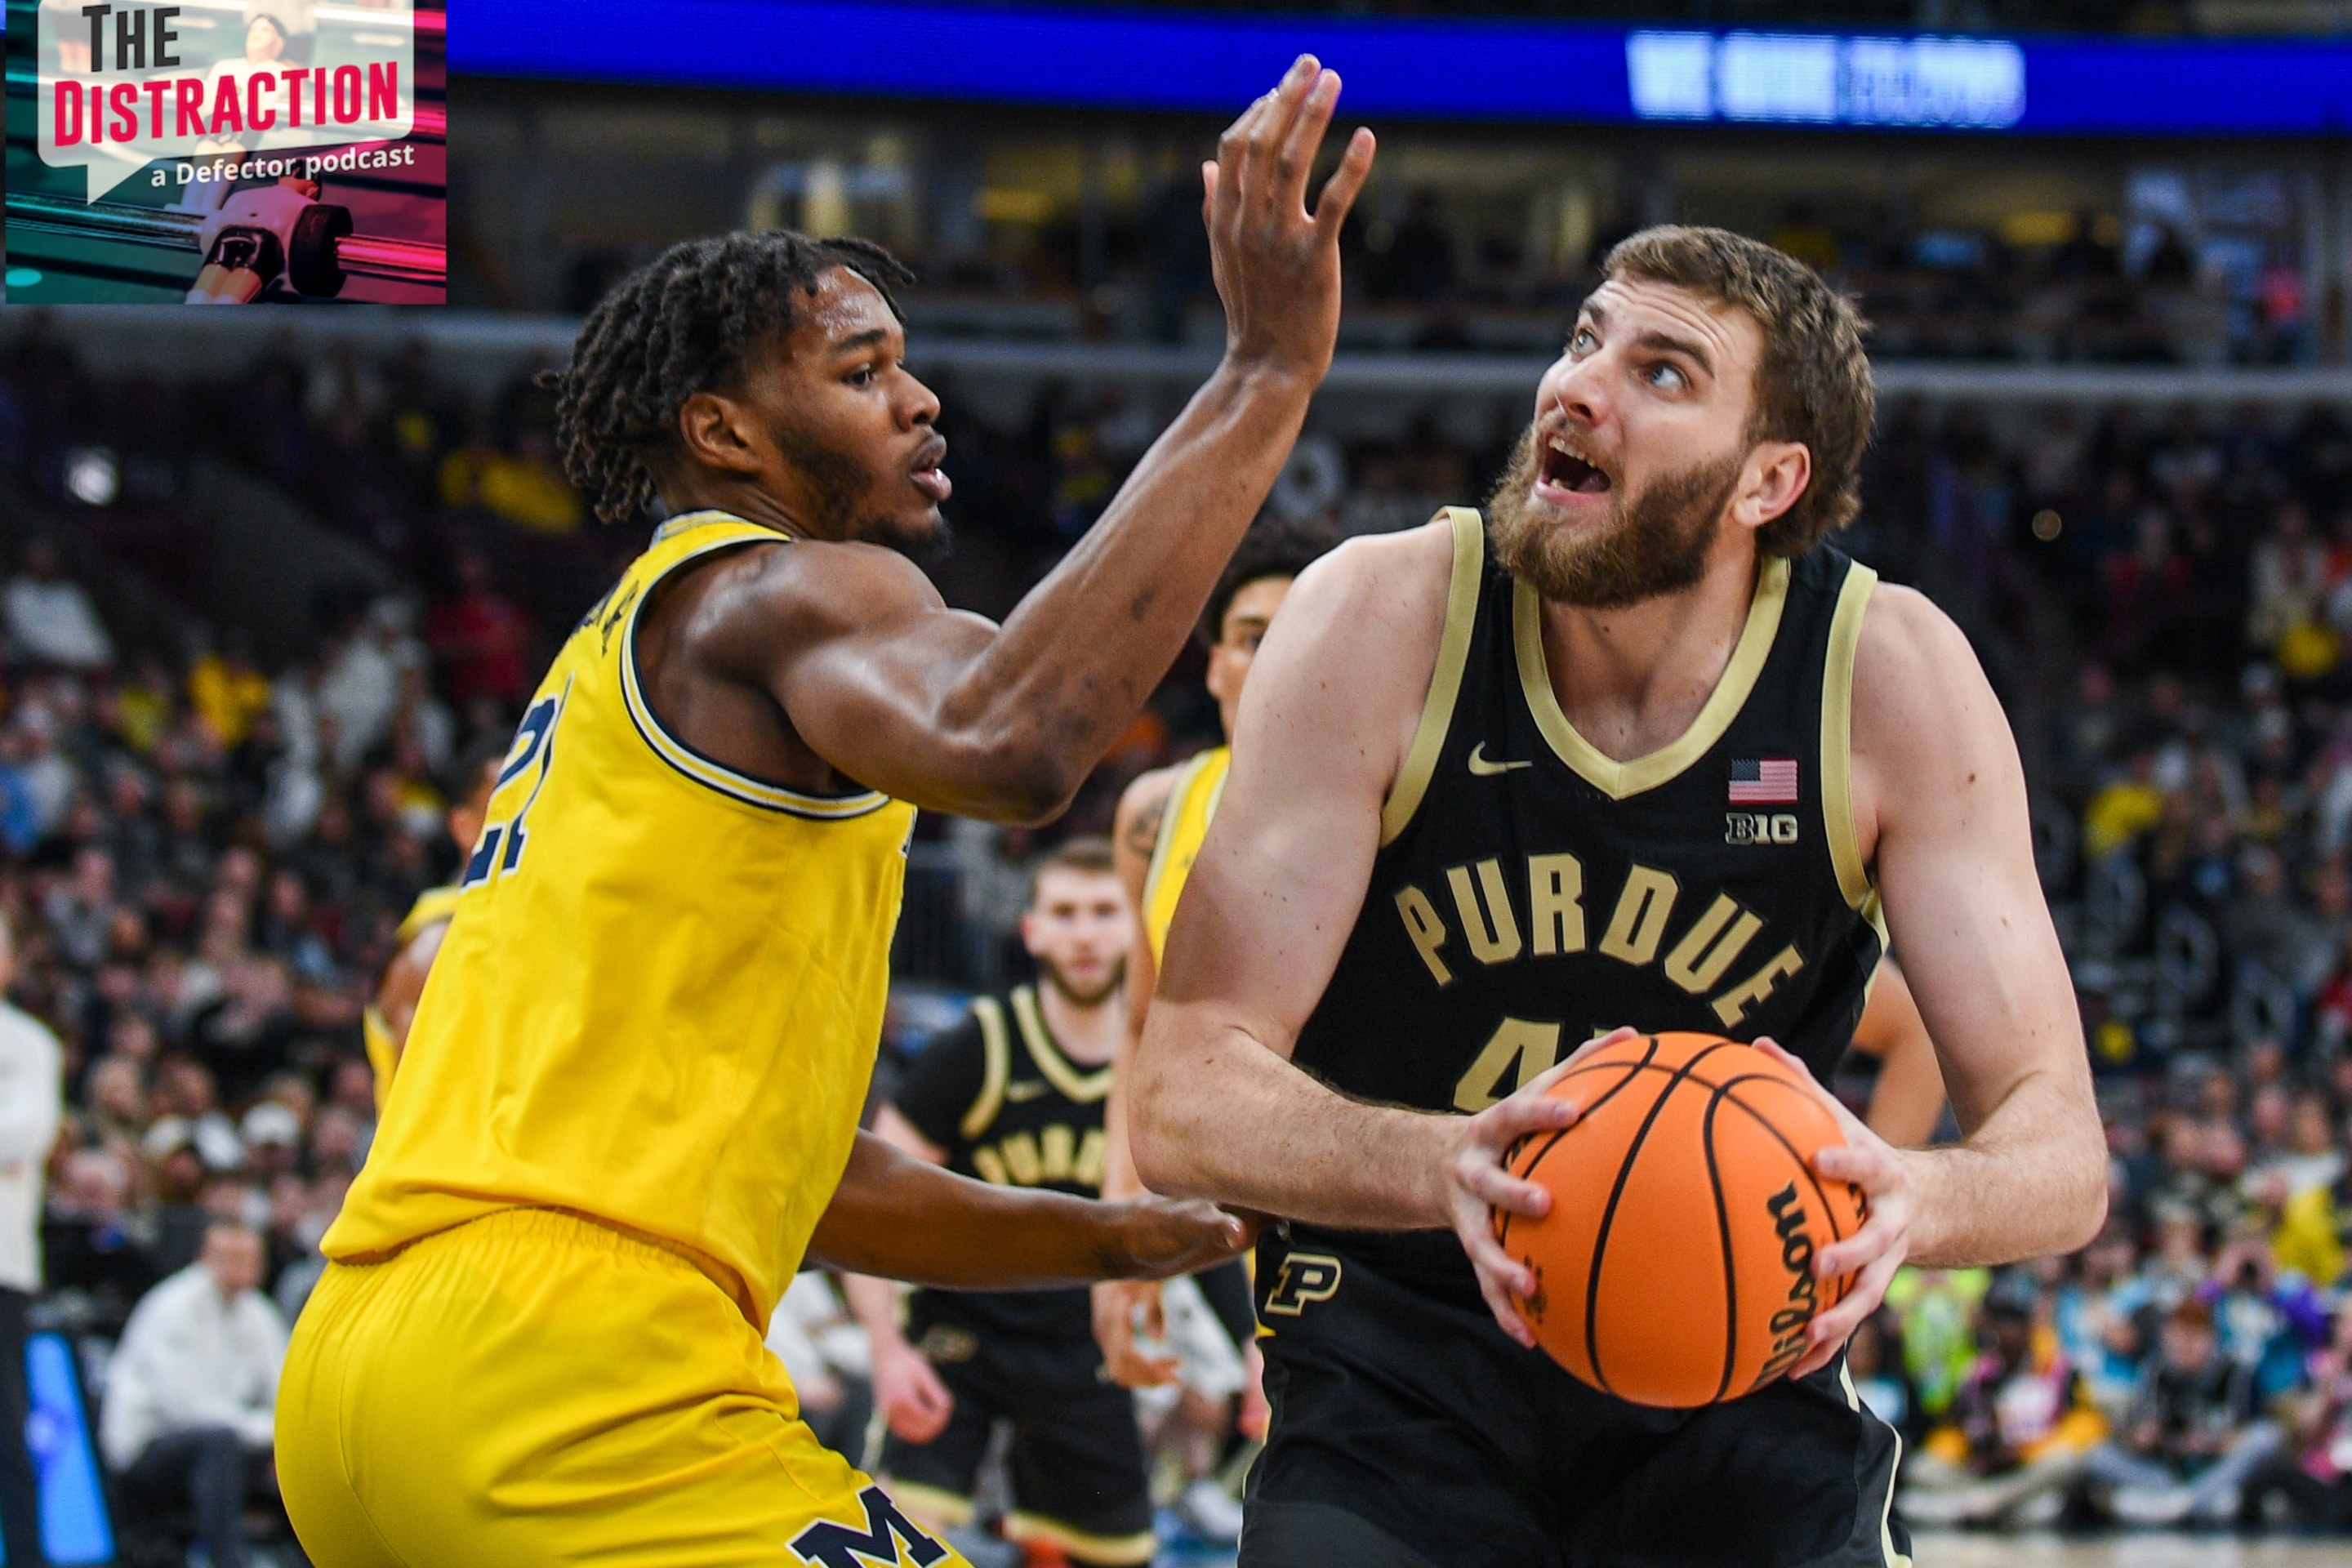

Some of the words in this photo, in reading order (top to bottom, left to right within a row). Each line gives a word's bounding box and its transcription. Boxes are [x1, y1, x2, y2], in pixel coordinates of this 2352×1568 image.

[1393, 853, 1806, 1029] PURDUE
[1264, 1251, 1343, 1317] P
[785, 1482, 951, 1568] M
